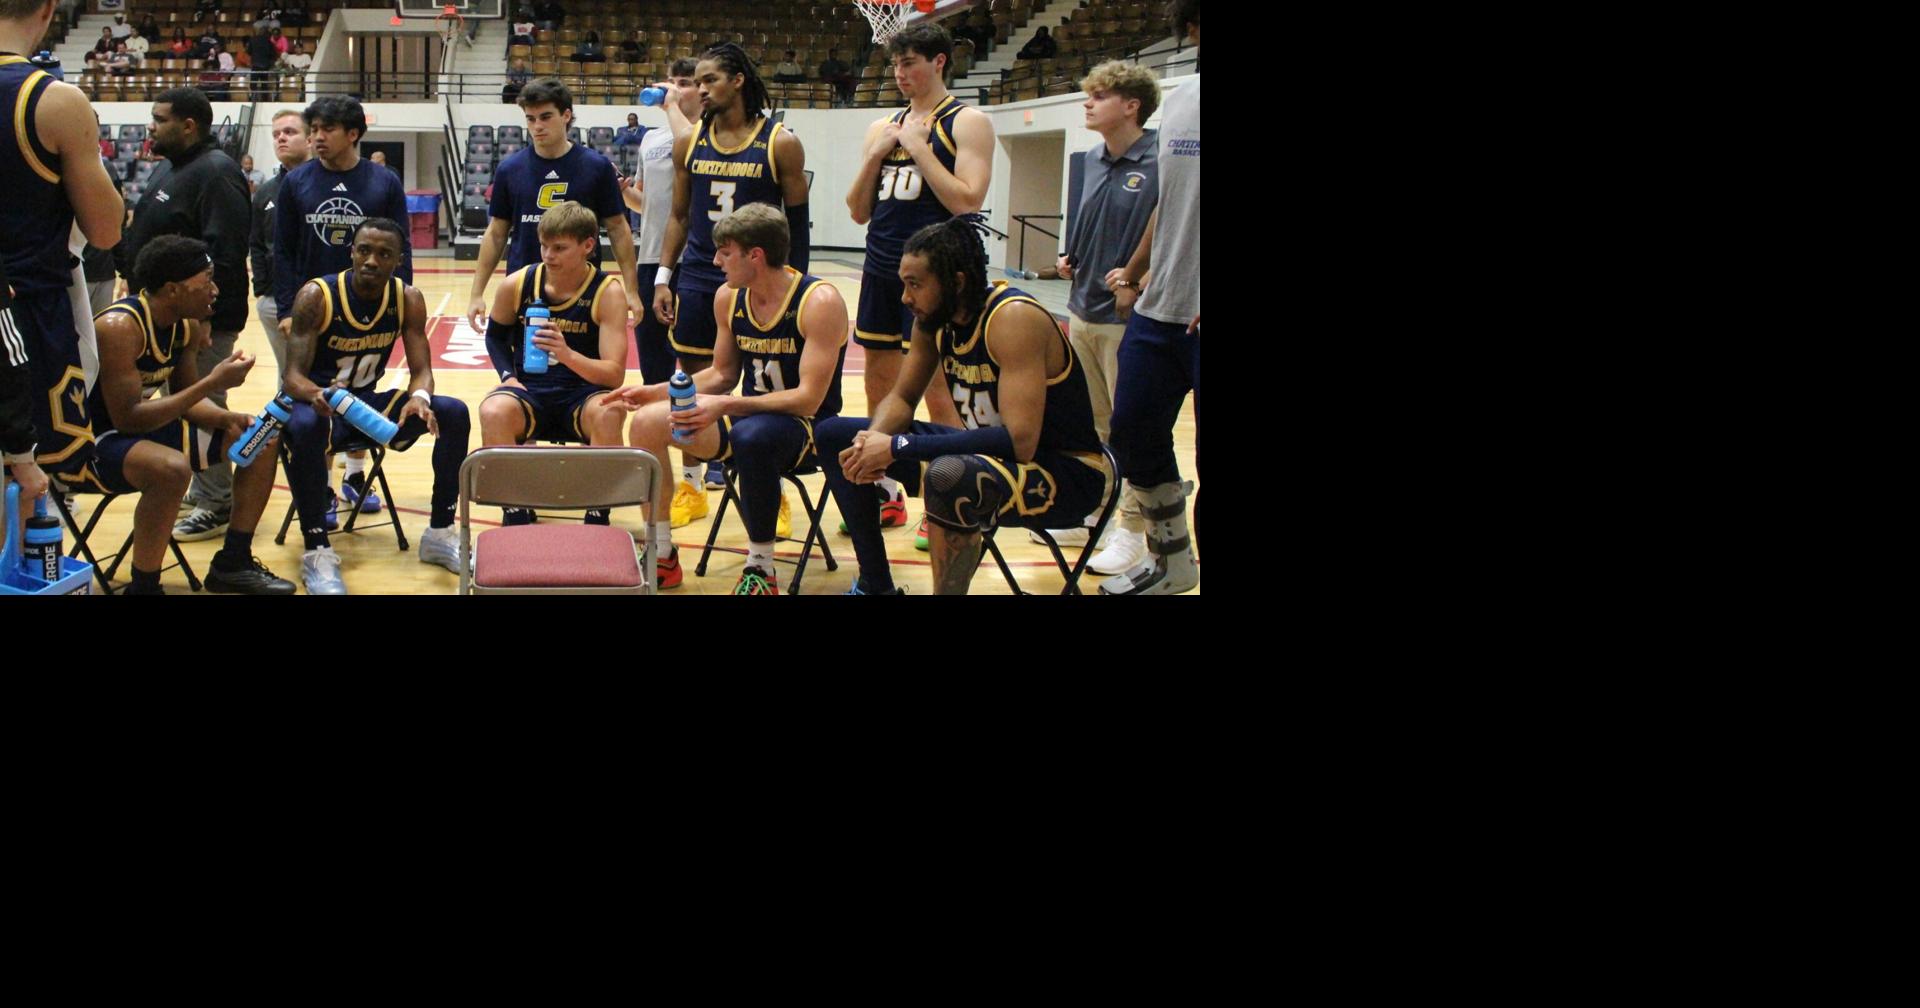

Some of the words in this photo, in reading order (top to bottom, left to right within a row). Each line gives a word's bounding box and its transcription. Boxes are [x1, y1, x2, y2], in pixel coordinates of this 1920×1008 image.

[692, 159, 763, 177] CHATTANOOGA
[878, 165, 922, 200] 30
[537, 182, 568, 209] C
[708, 181, 736, 222] 3
[305, 213, 368, 225] CHATTANOO
[521, 214, 542, 223] BAS
[330, 230, 346, 245] C
[327, 353, 381, 388] 10
[752, 358, 785, 392] 11
[952, 382, 1002, 431] 34
[240, 416, 277, 457] POWERADE
